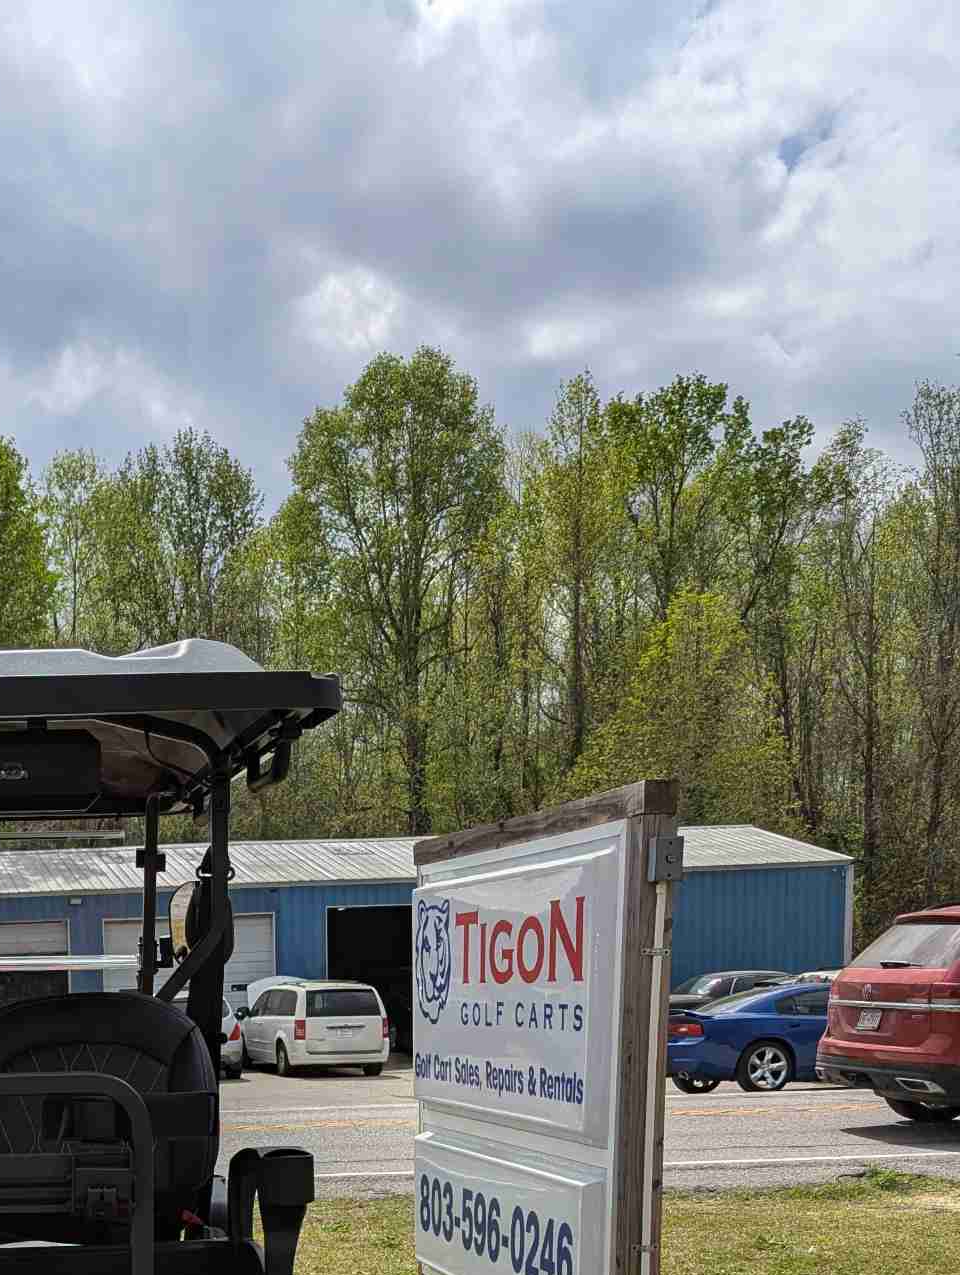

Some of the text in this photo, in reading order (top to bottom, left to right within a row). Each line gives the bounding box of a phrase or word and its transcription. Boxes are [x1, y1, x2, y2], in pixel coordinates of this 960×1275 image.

[455, 896, 585, 984] TIGON
[460, 1002, 583, 1031] GOLF CARTS
[415, 1052, 584, 1104] Golf Cart Sales, Repairs & Rentals
